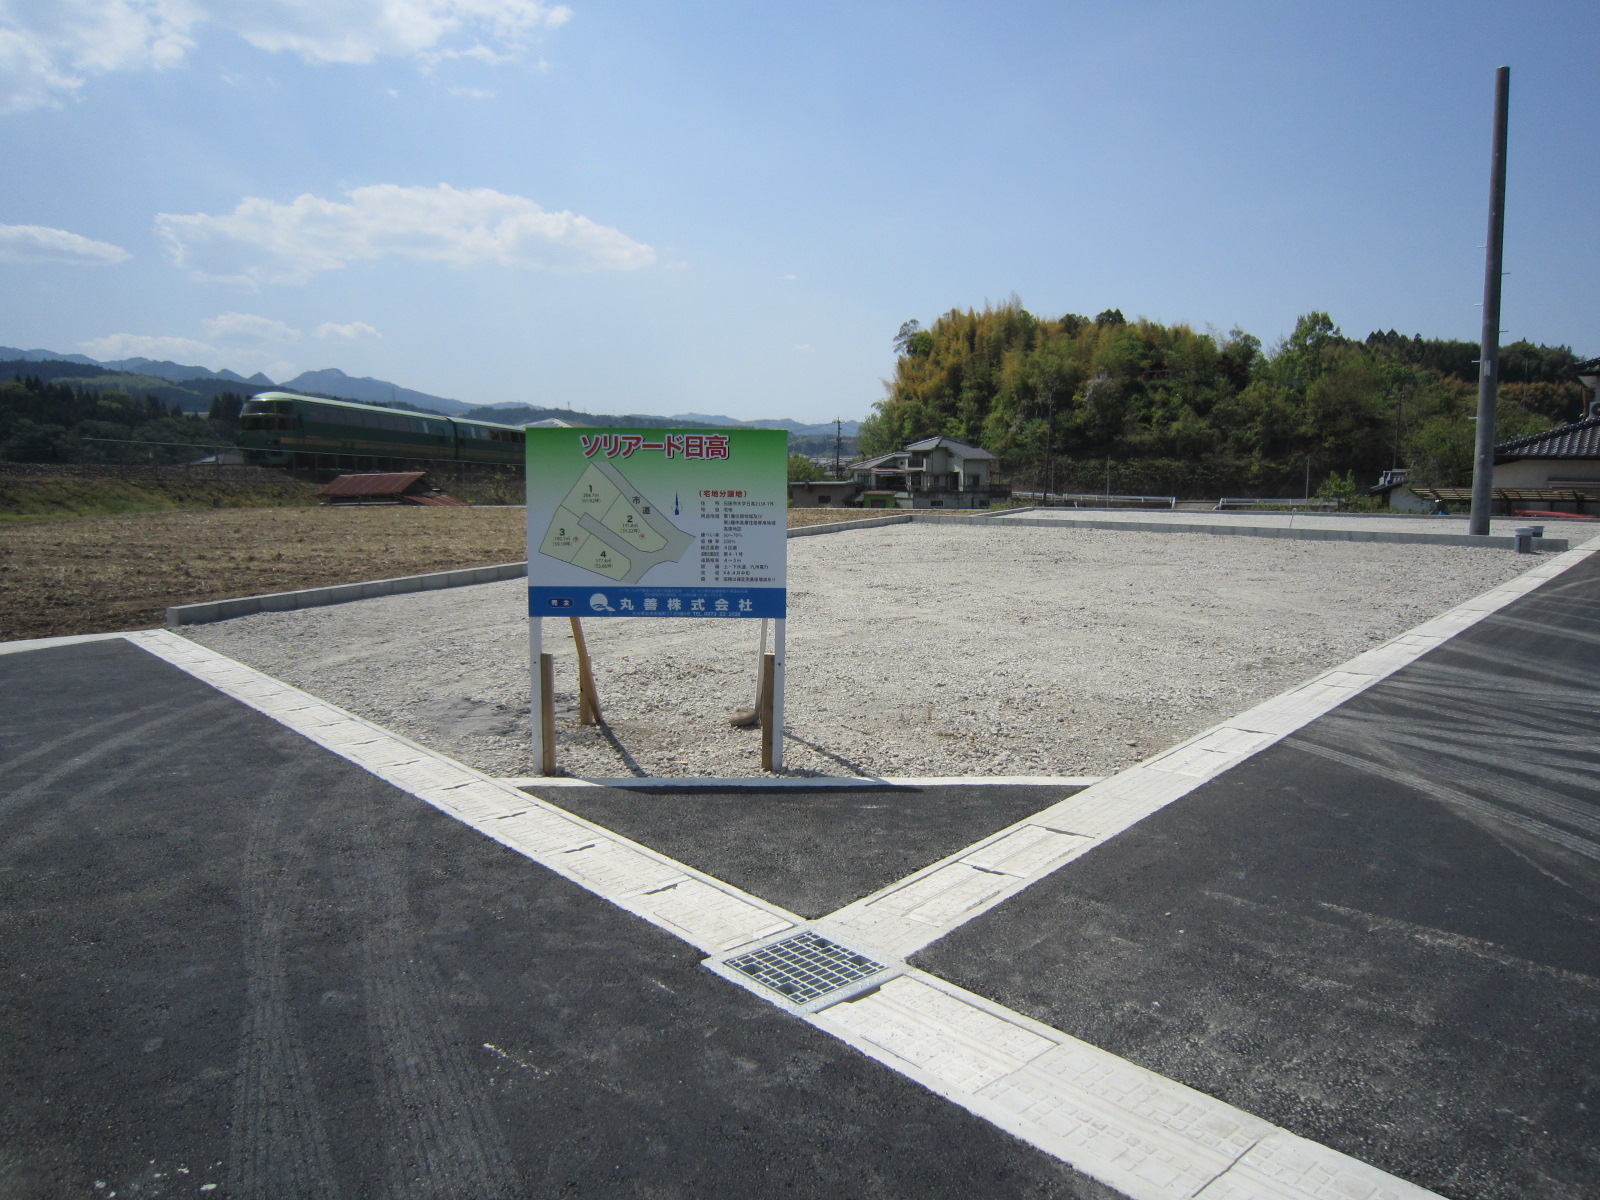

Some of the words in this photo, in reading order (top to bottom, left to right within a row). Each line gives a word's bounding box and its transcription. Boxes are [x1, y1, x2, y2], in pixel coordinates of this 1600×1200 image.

[581, 434, 729, 459] ソリアード日高
[627, 515, 633, 523] 2
[559, 528, 565, 536] 3
[600, 550, 606, 558] 4
